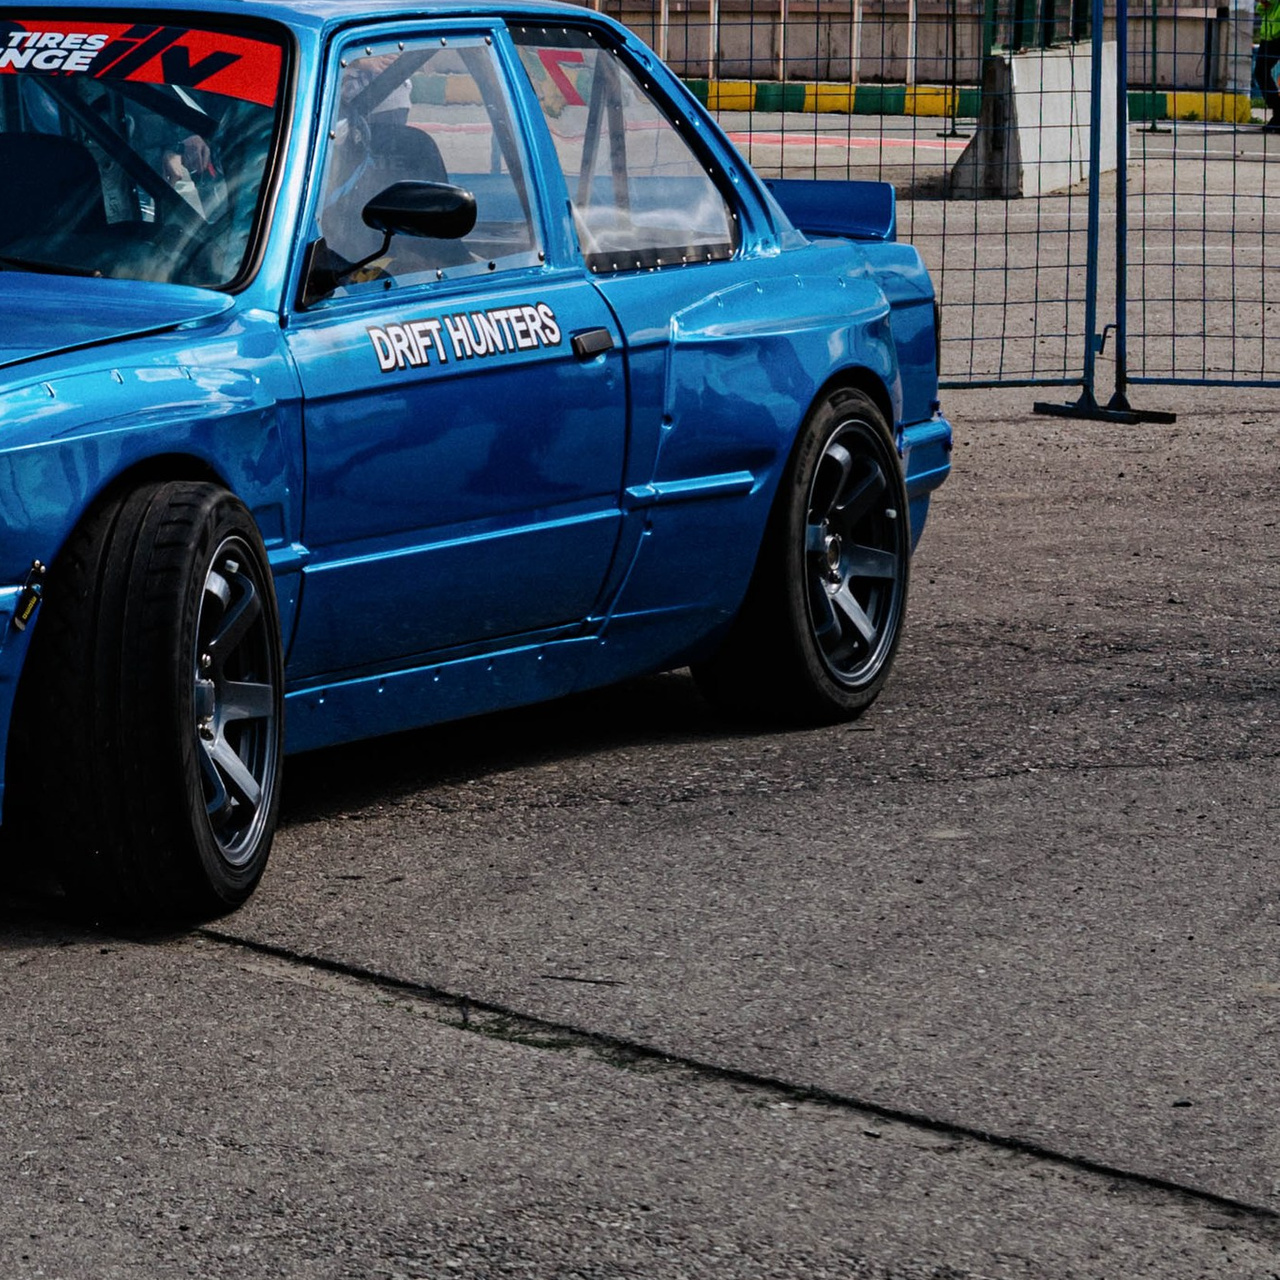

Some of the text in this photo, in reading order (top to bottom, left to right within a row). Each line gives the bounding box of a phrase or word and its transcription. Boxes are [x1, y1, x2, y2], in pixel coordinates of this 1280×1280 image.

[8, 32, 109, 51] TIRES
[367, 301, 563, 372] DRIFT HUNTERS
